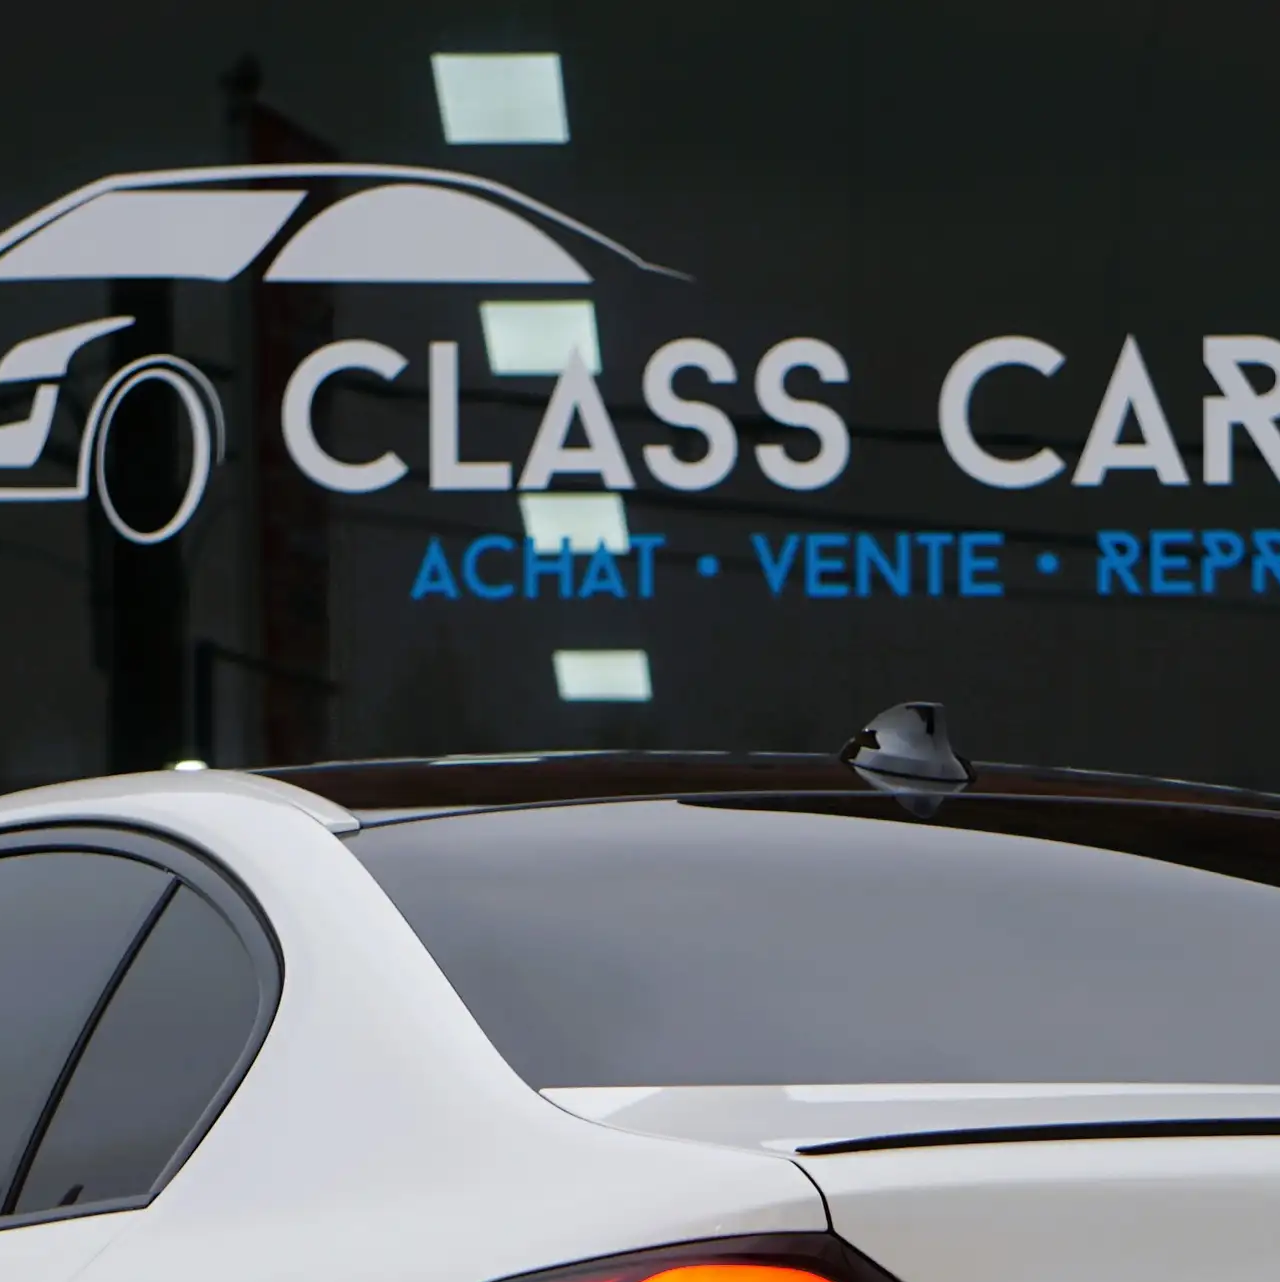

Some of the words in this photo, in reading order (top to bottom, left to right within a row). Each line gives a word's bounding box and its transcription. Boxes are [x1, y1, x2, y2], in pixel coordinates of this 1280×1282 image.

[281, 336, 851, 493] CLASS
[410, 535, 665, 598] ACHAT
[752, 532, 1004, 597] VENTE
